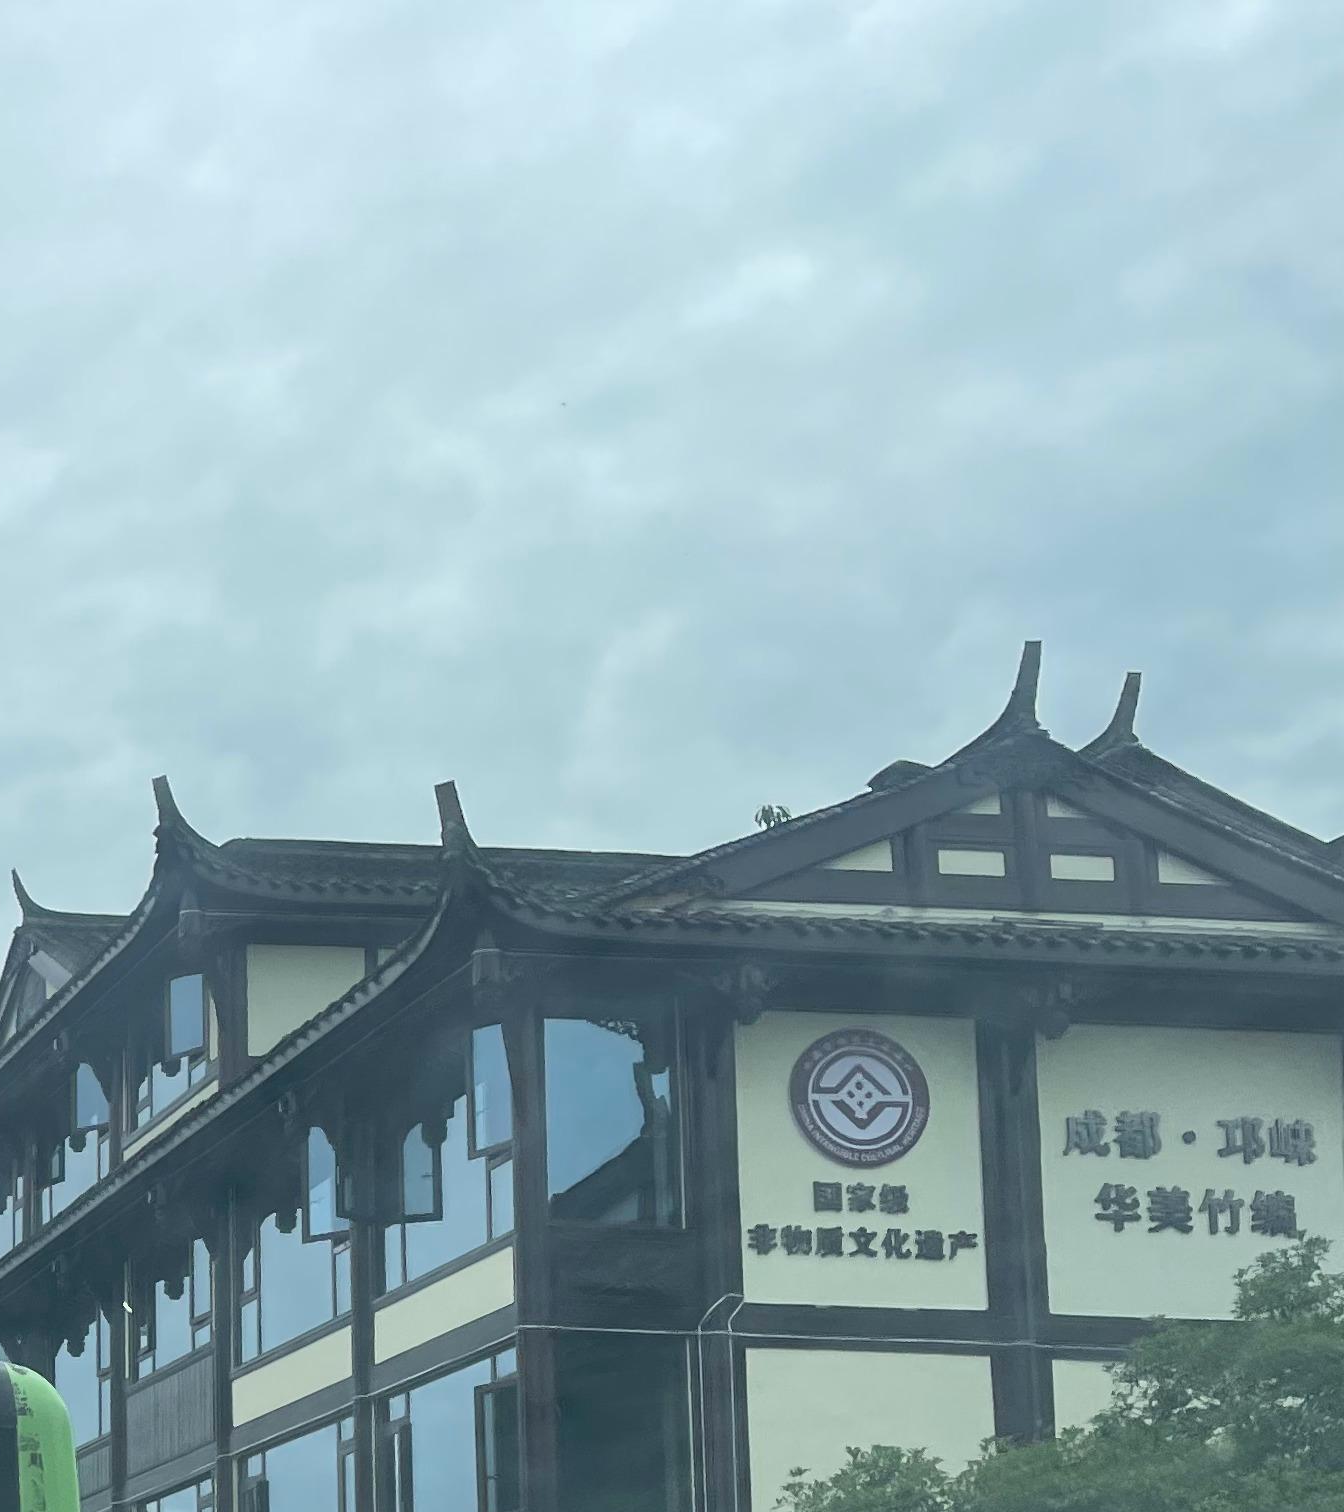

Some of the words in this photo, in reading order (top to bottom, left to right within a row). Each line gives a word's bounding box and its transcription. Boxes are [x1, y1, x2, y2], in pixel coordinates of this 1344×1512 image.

[813, 1180, 910, 1215] 国家级
[1094, 1182, 1300, 1239] 华美竹编
[746, 1223, 979, 1261] 非物质文化遗产
